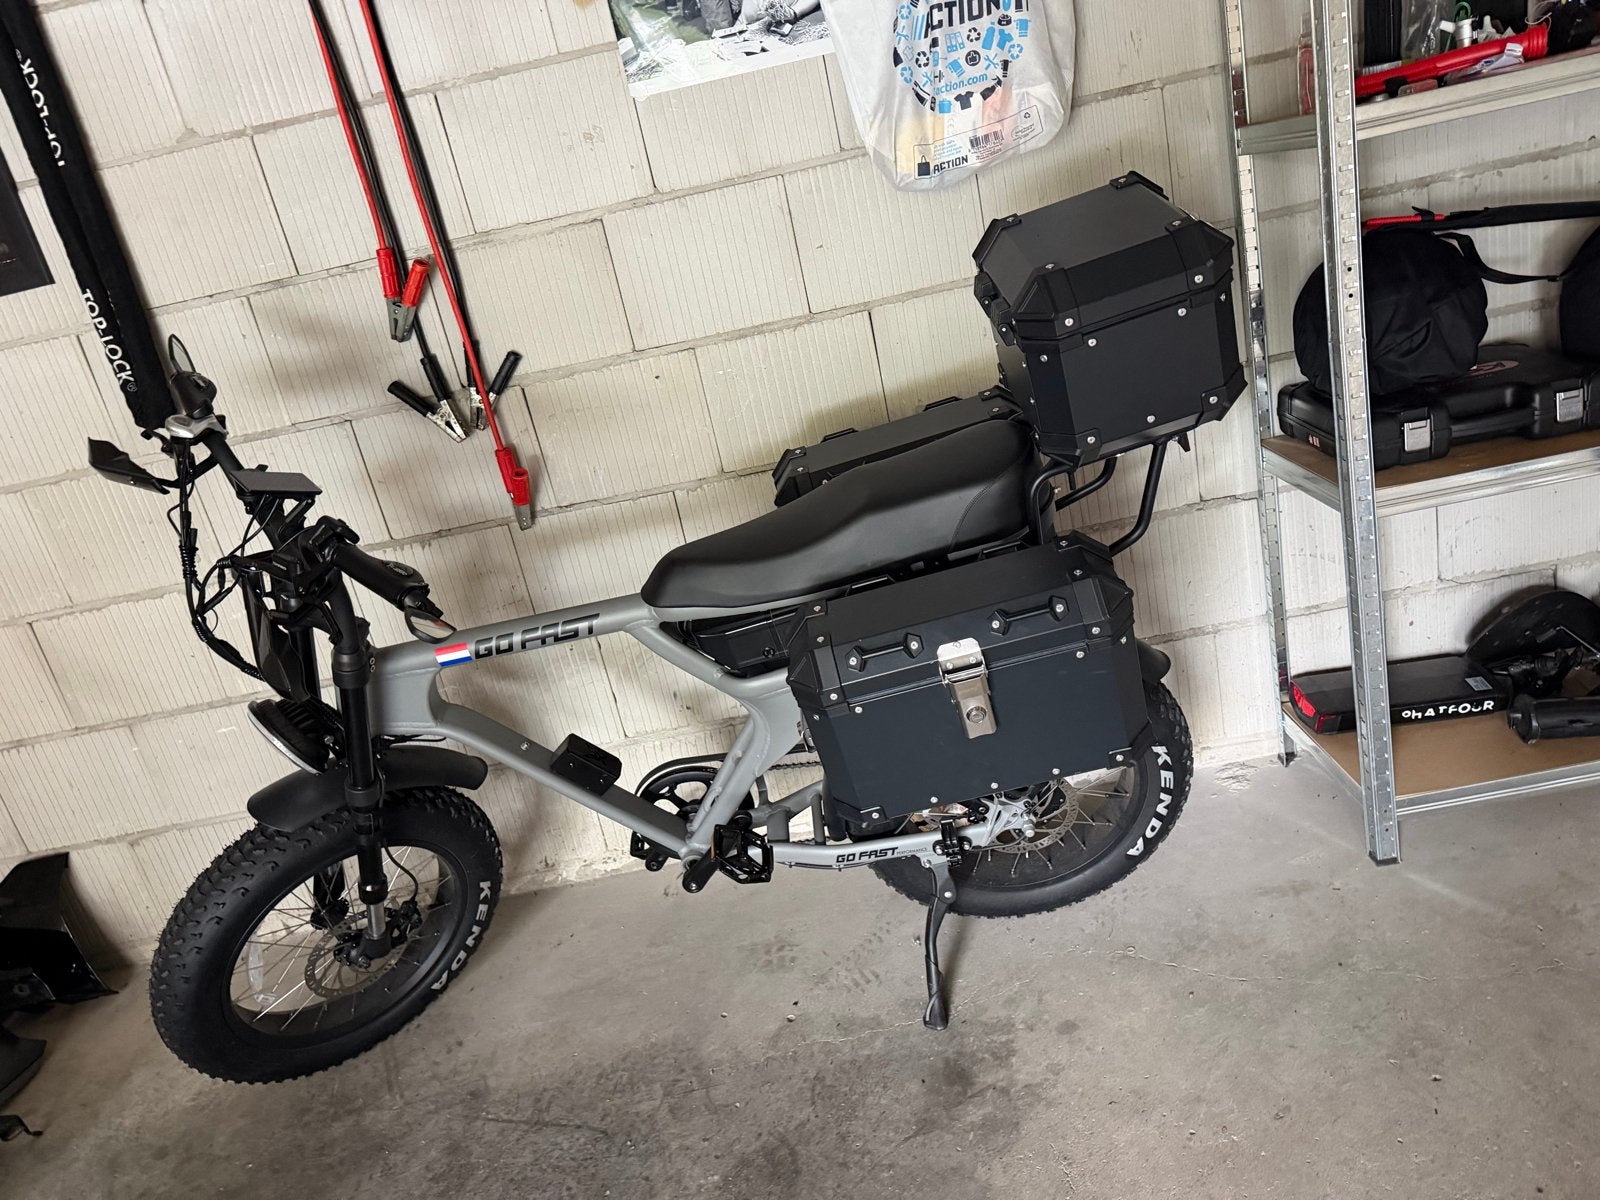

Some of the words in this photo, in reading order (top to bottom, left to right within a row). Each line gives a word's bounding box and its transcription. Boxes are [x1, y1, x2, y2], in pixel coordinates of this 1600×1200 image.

[935, 73, 988, 96] action.com
[933, 154, 968, 175] ACTION
[475, 632, 514, 660] GO
[521, 612, 600, 650] FAST
[1126, 745, 1174, 856] KENDA
[836, 852, 856, 863] GO
[858, 846, 899, 861] FAST
[430, 880, 491, 990] KENDA
